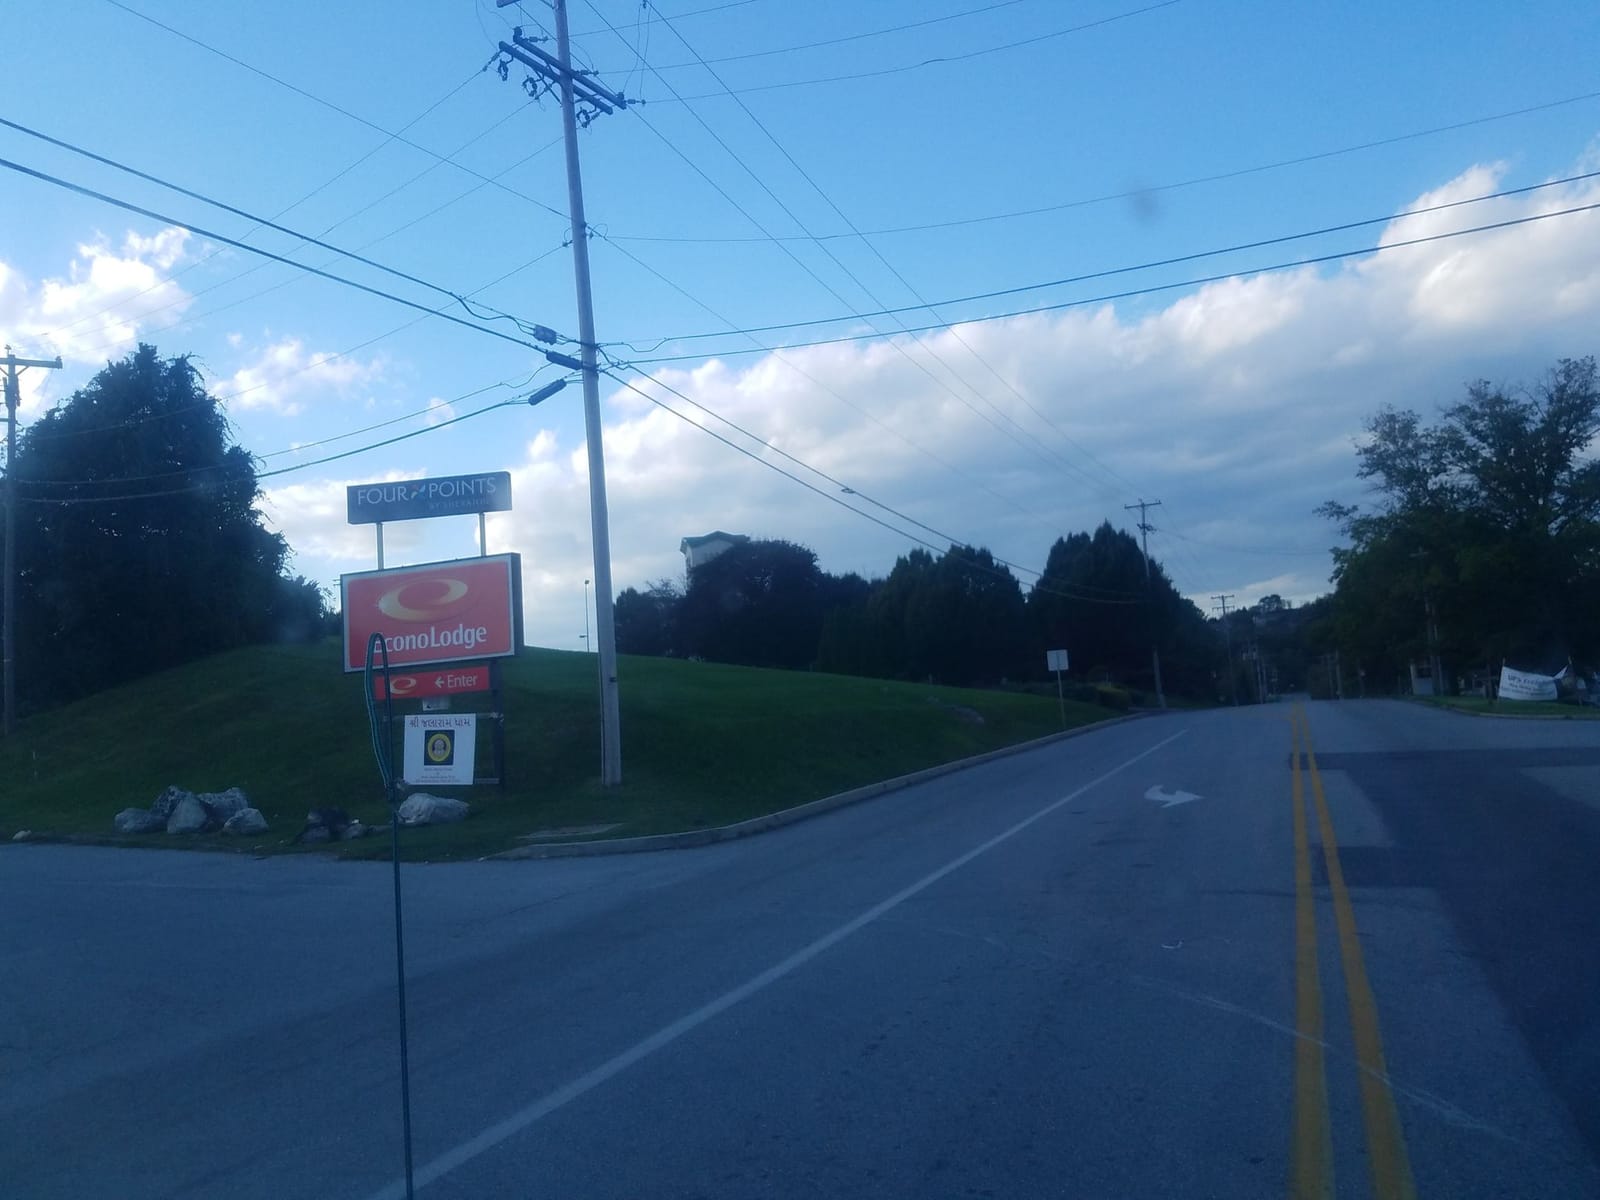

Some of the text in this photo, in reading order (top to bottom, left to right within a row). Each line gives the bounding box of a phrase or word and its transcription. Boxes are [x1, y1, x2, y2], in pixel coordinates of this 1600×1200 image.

[358, 477, 496, 505] FOUR POINTS
[447, 674, 478, 688] Enter
